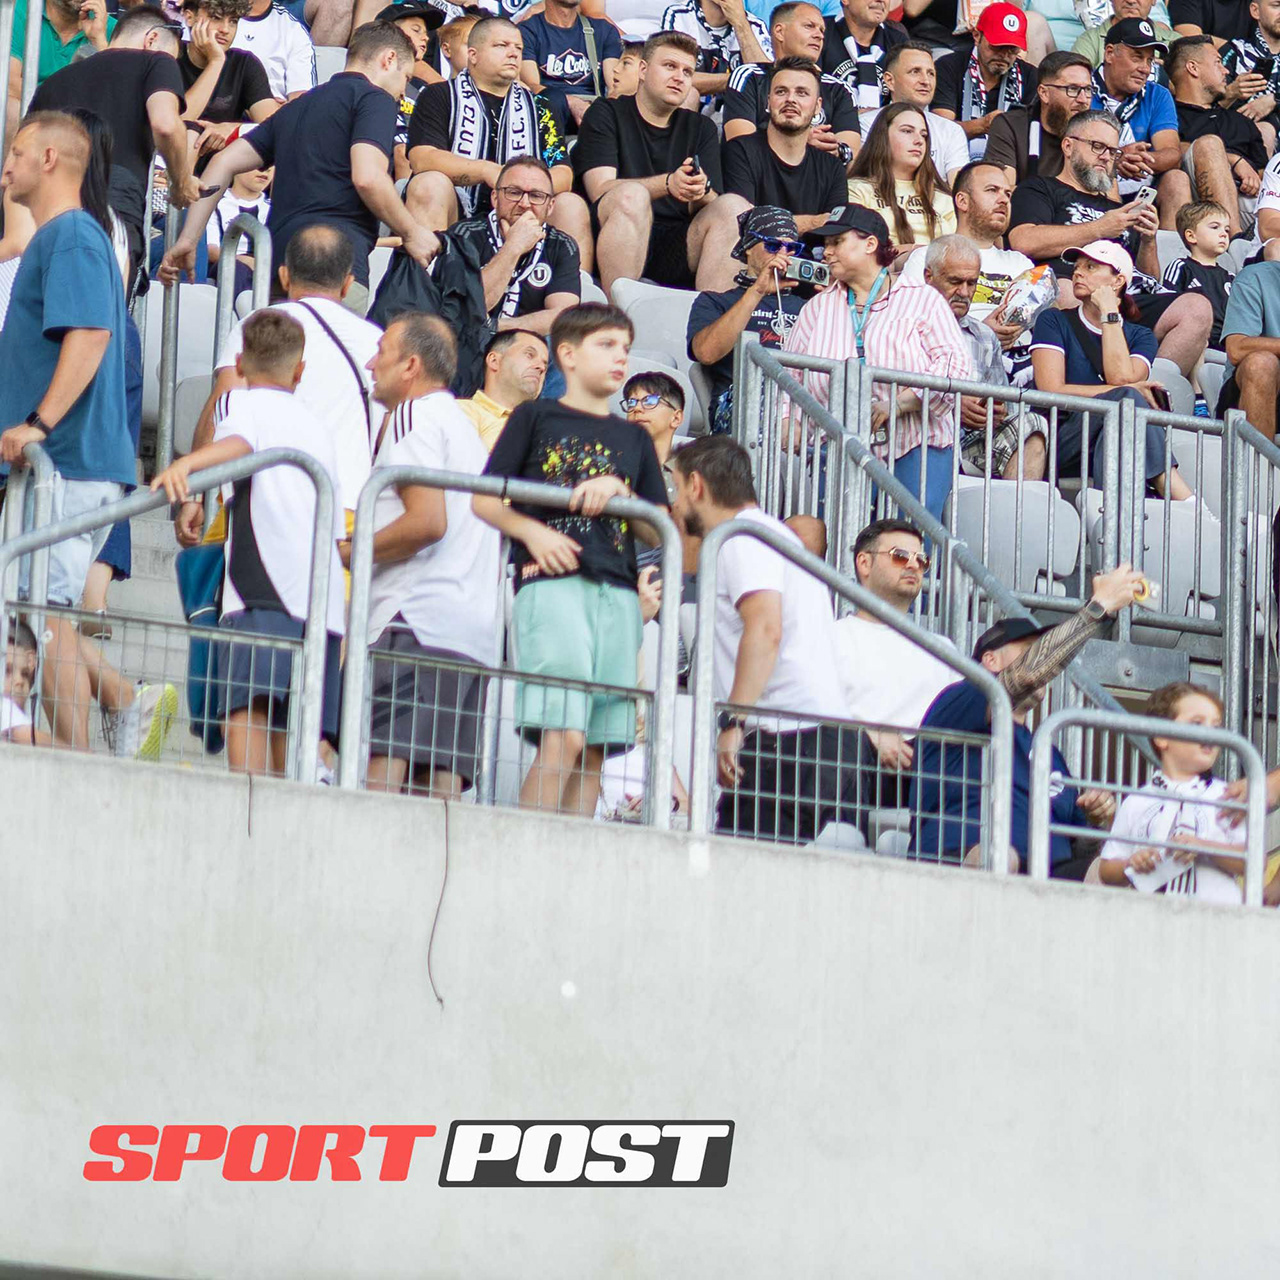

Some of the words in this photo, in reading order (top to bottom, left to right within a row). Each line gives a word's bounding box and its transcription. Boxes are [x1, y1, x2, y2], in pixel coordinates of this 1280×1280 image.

[547, 53, 563, 74] Lee
[457, 104, 475, 156] CLUJ
[511, 117, 526, 151] F.C.
